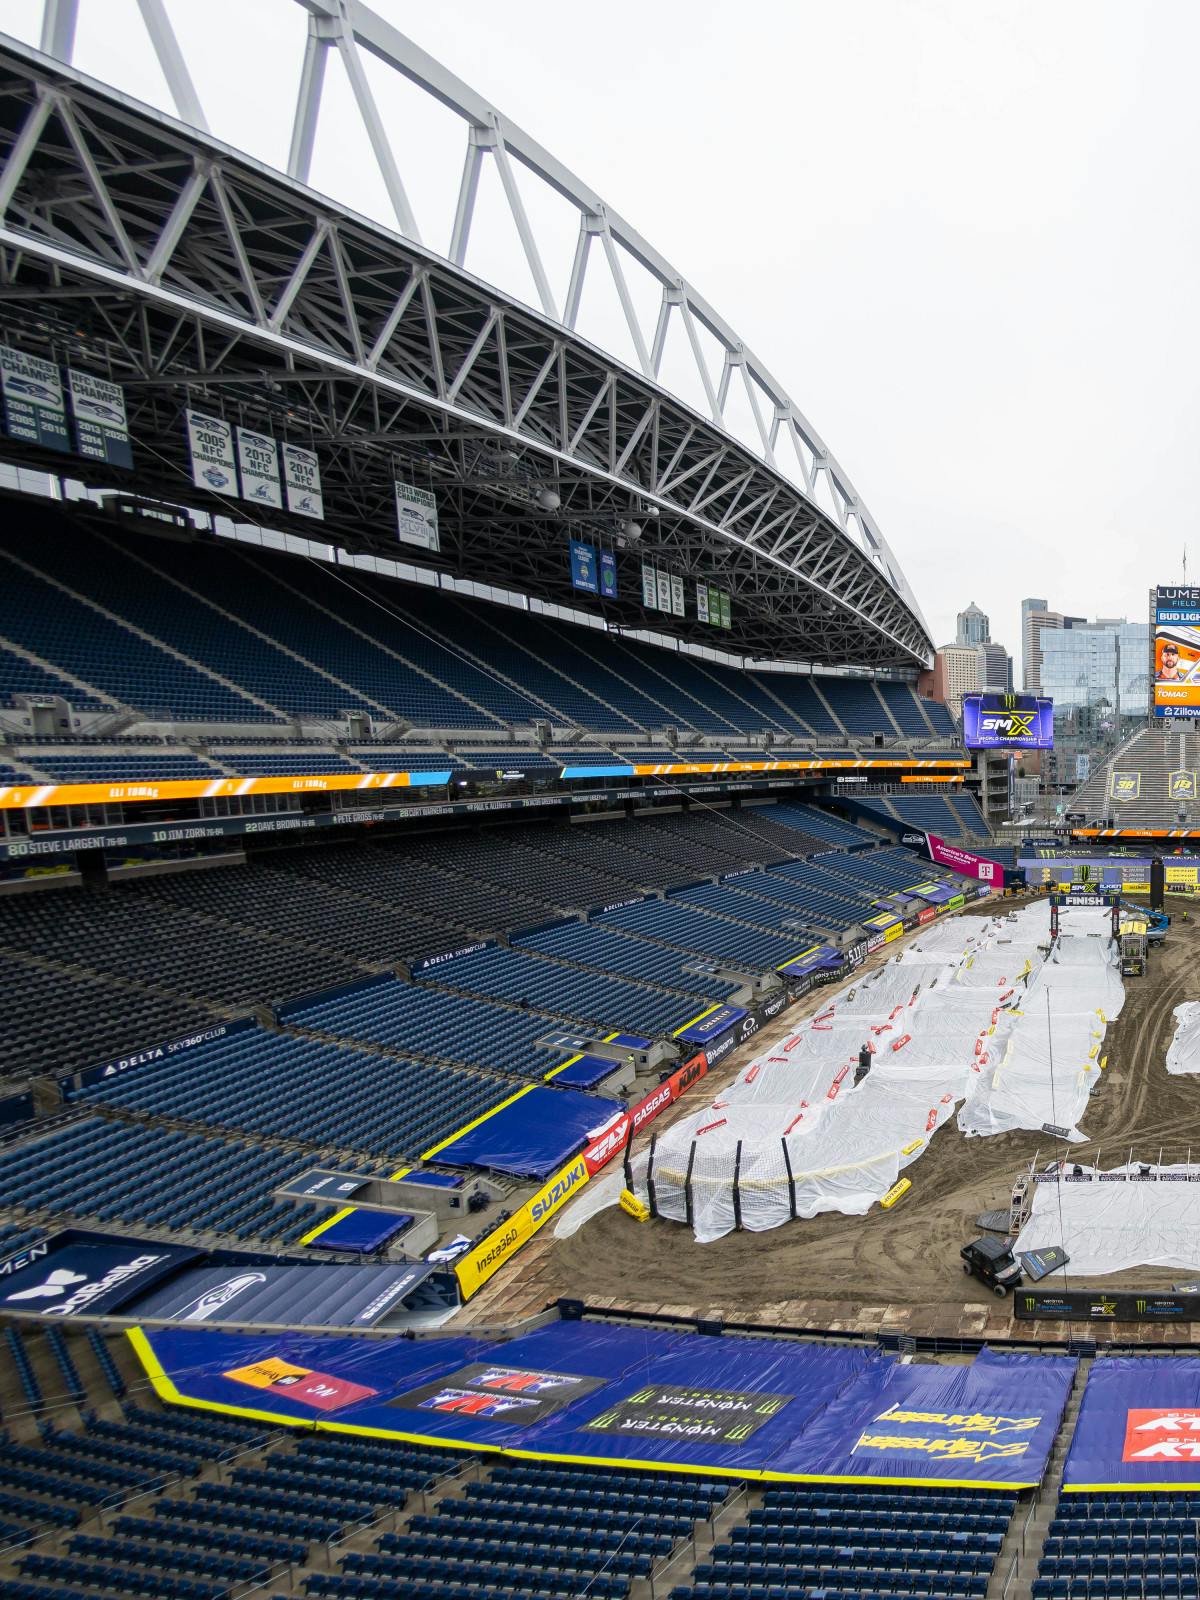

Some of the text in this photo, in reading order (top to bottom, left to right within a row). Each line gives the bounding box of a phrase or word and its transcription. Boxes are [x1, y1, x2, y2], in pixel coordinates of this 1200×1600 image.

[2, 361, 59, 386] CHAMPS
[71, 371, 122, 397] NFC WEST
[72, 382, 123, 408] CHAMPS
[41, 422, 67, 436] 2010
[80, 420, 128, 442] 2013 2020
[80, 433, 102, 446] 2014
[196, 431, 226, 449] 2005
[202, 444, 223, 458] NFC
[245, 447, 272, 464] 2013
[250, 460, 270, 473] NFC
[290, 462, 314, 478] 2014
[294, 474, 312, 486] NFC
[396, 483, 435, 502] 2013 WORLD
[1159, 612, 1180, 621] BUD
[1157, 688, 1188, 698] TOMAC
[981, 715, 1034, 736] SMX
[337, 812, 372, 824] PETE GROSS
[409, 807, 422, 817] CURT
[423, 806, 442, 816] WARNER
[153, 826, 206, 842] 10 JIM ZORN
[245, 818, 300, 833] 22 DAVE BROWN
[8, 836, 105, 856] 80 STEVE LARGENT
[935, 844, 978, 863] America's Best
[1072, 883, 1096, 893] SMX
[608, 902, 624, 912] DELTA
[1065, 896, 1104, 905] FINISH
[430, 952, 454, 966] DELTA
[849, 945, 861, 963] 5.11
[699, 1010, 731, 1031] OAKLEY
[740, 1023, 760, 1042] OAKLEY
[712, 1035, 735, 1059] Husqvarna
[118, 1047, 164, 1071] DELTA
[678, 1062, 701, 1092] KTM
[633, 1087, 671, 1126] GASGAS
[590, 1118, 629, 1162] FLY
[531, 1161, 586, 1223] SUZUKI
[883, 1180, 904, 1205] DUNLOP
[622, 1196, 640, 1213] DUNLOP
[476, 1228, 518, 1274] Insta360
[361, 1273, 416, 1320] SEAHAWKS
[1090, 1303, 1117, 1314] SMX
[306, 1382, 339, 1398] NC
[680, 1392, 745, 1401] ENERGY
[646, 1415, 716, 1425] ENERGY
